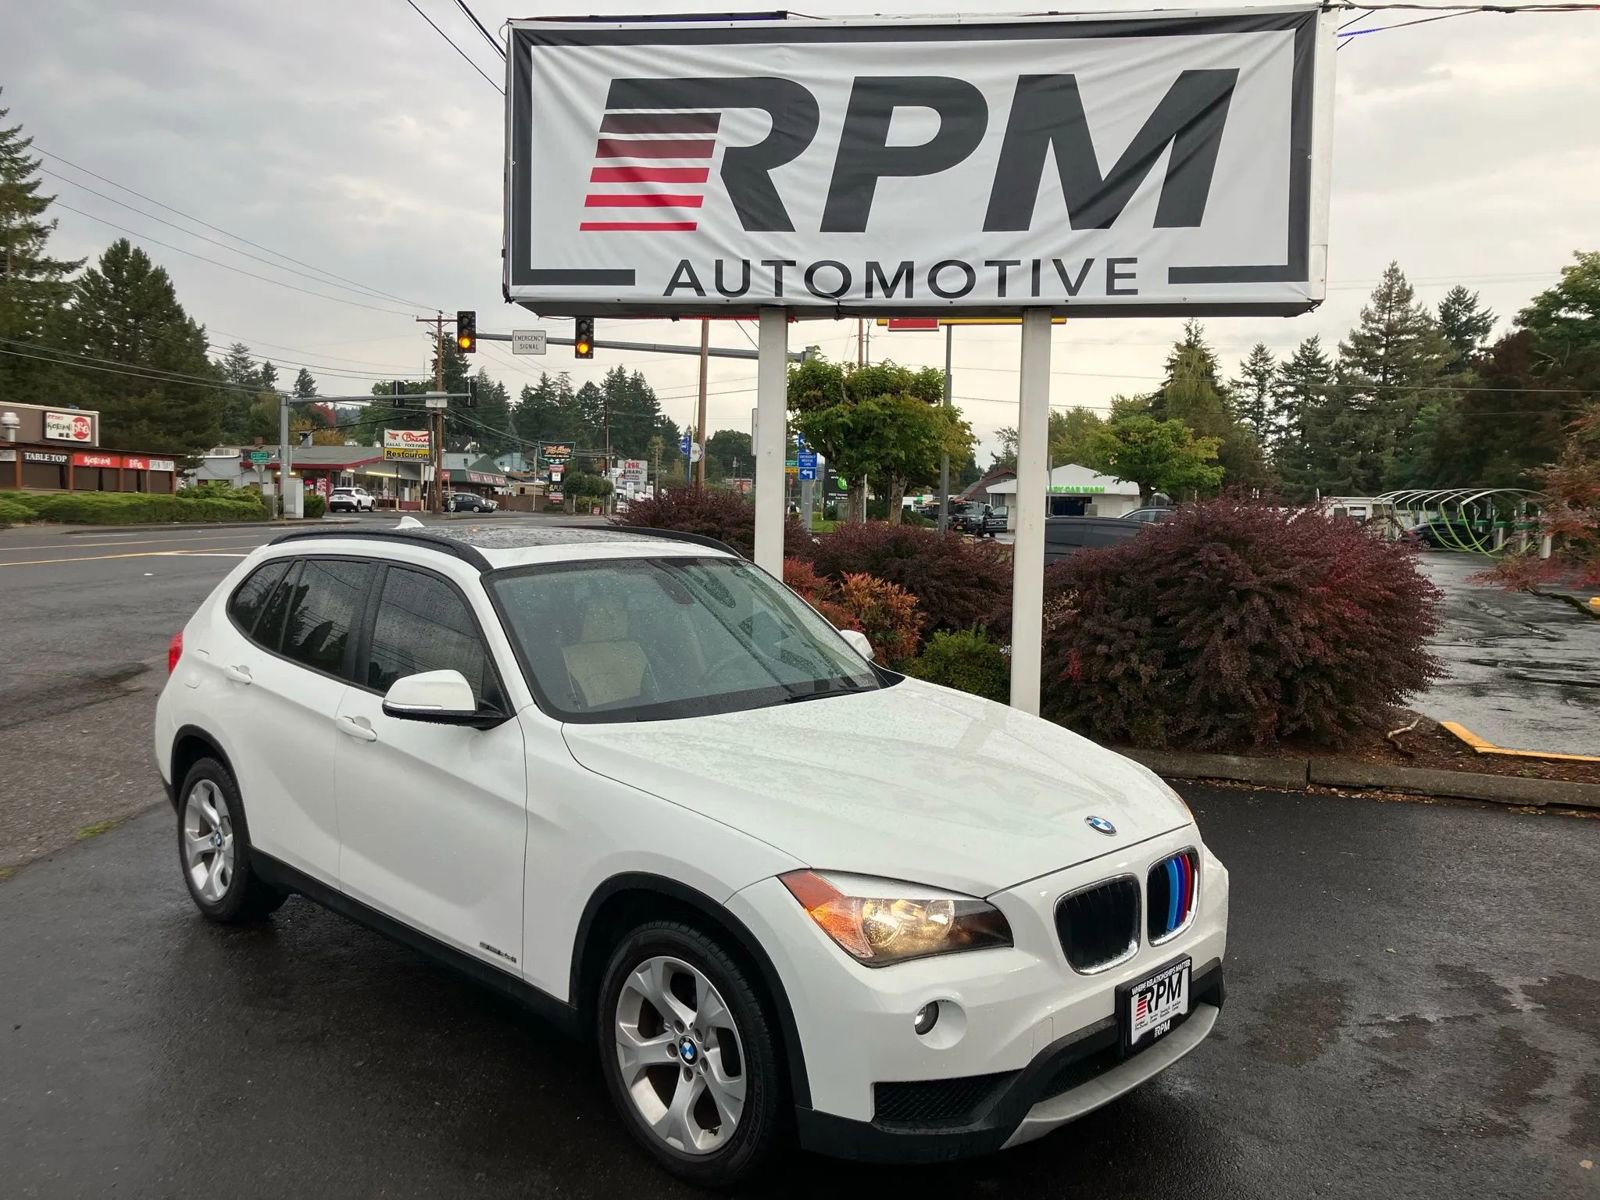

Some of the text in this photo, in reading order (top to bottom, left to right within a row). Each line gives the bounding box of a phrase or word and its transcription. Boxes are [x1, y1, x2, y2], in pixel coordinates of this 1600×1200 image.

[579, 67, 1240, 232] RPM
[662, 257, 1139, 299] AUTOMOTIVE
[24, 453, 50, 462] TABLE
[51, 454, 68, 463] TOP
[1082, 485, 1105, 494] WASH
[1146, 966, 1176, 987] RELATIONSHIPS
[1175, 959, 1191, 973] MATTER
[1135, 969, 1183, 1021] RPM
[1154, 1020, 1171, 1038] RPM
